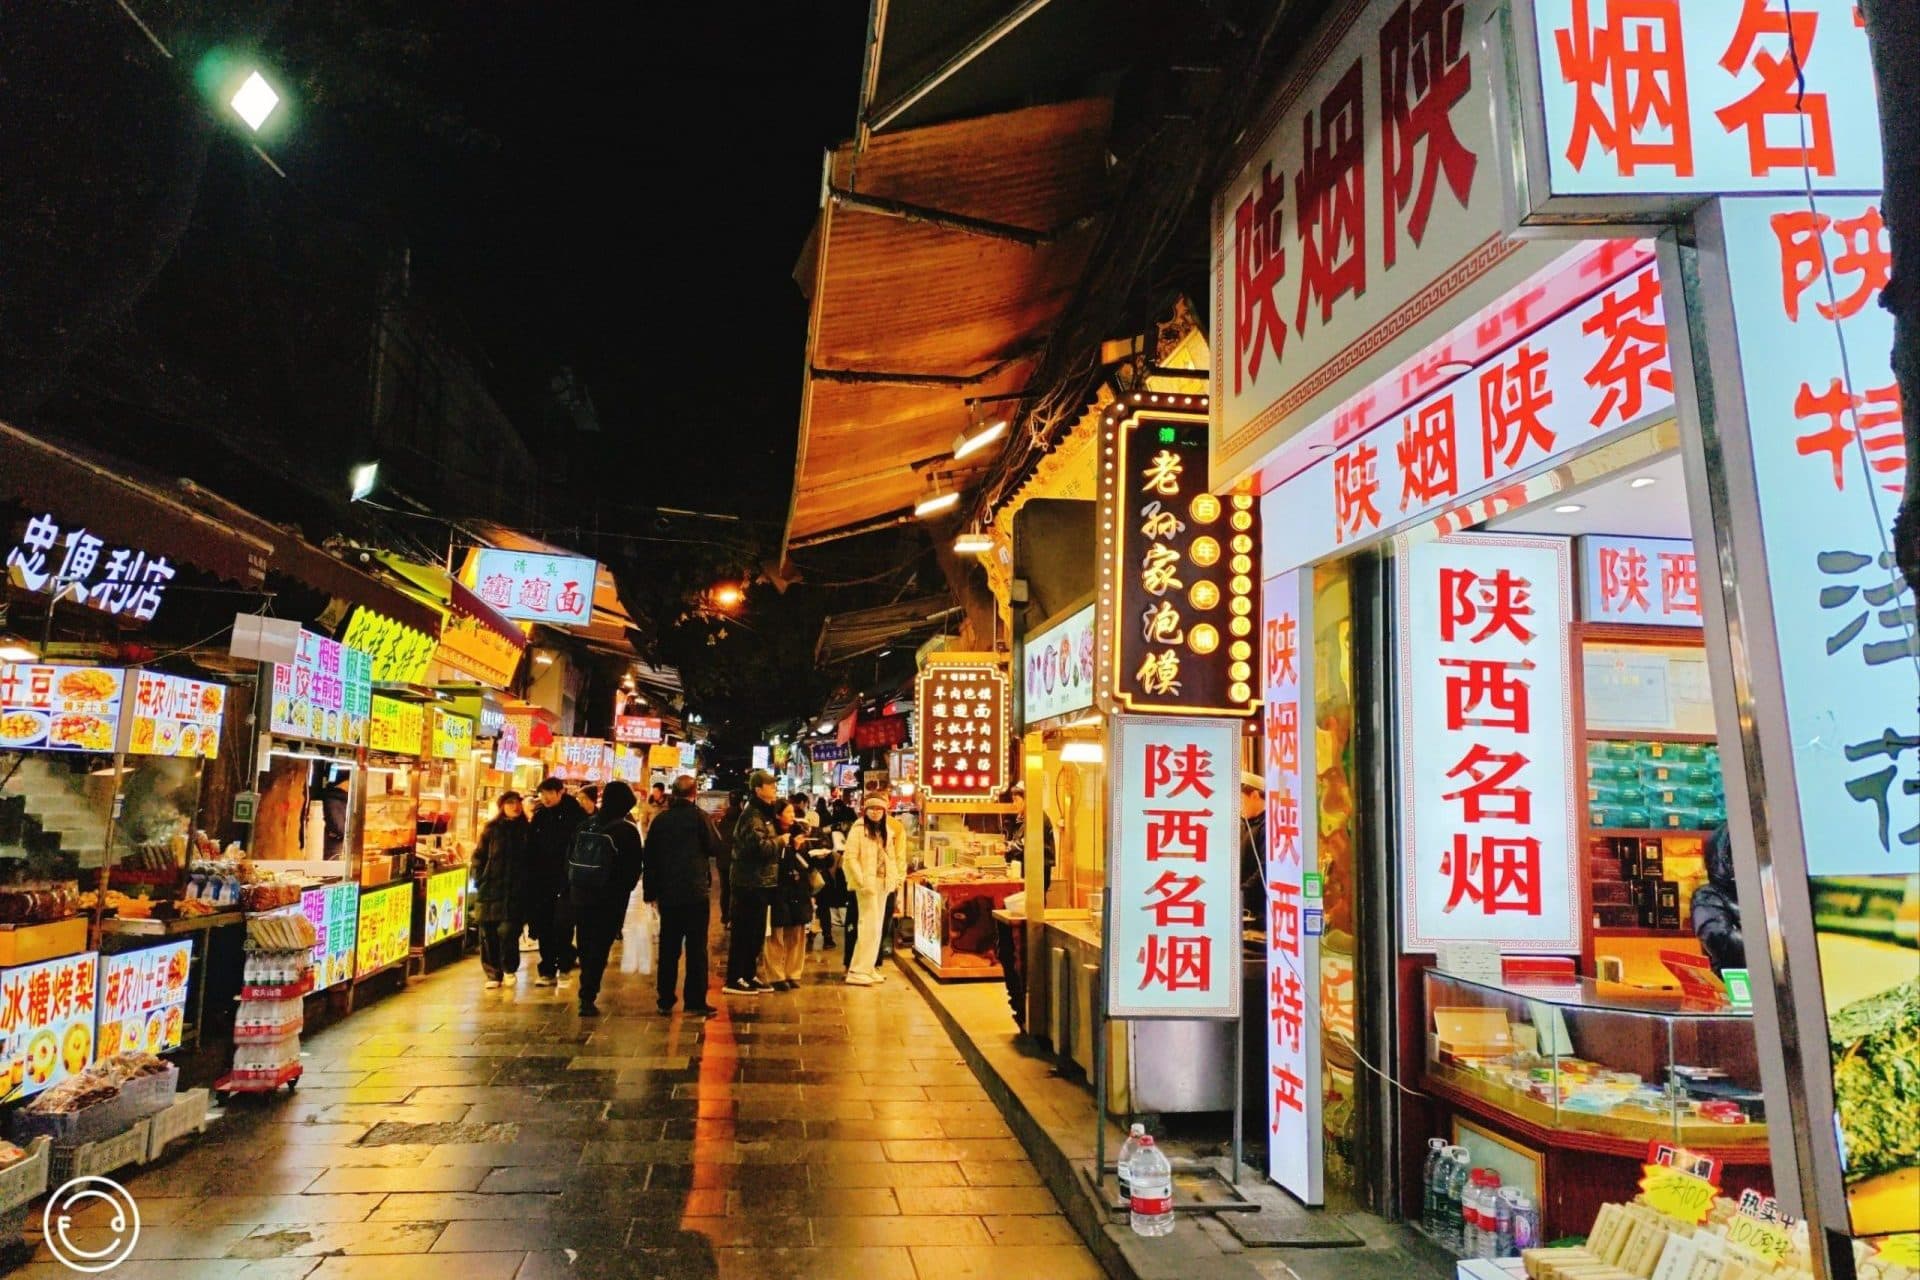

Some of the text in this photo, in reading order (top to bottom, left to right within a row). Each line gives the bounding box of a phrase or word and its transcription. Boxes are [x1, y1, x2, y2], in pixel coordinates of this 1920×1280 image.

[1334, 268, 1675, 544] 陕烟陕茶
[6, 513, 176, 621] 忠便利店
[1136, 449, 1186, 697] 老孙家泡馍
[1599, 546, 1703, 616] 陕西
[1438, 567, 1543, 918] 陕西名烟
[1137, 744, 1216, 993] 陕西名烟
[0, 958, 95, 1034] 冰糖烤梨
